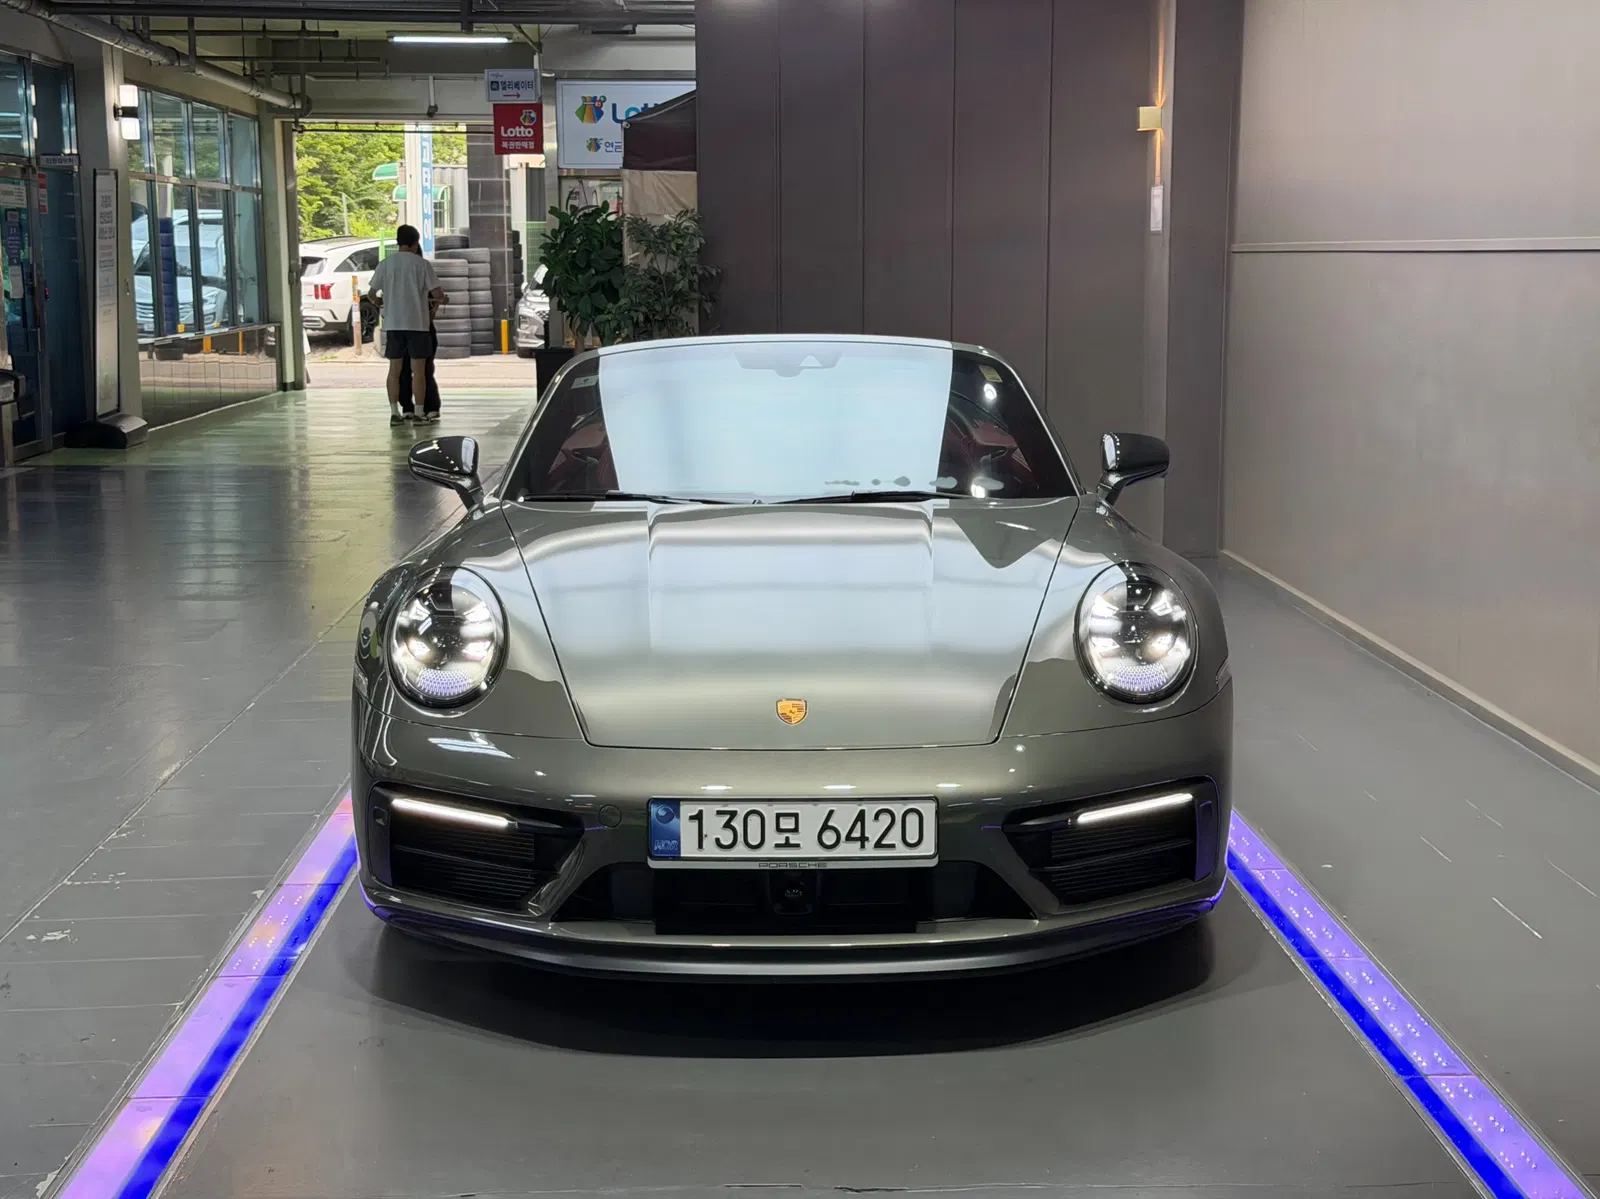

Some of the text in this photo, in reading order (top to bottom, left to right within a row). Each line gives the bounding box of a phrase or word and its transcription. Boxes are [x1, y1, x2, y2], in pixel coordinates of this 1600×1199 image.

[501, 126, 534, 137] Lotto
[688, 807, 925, 850] 130모 6420
